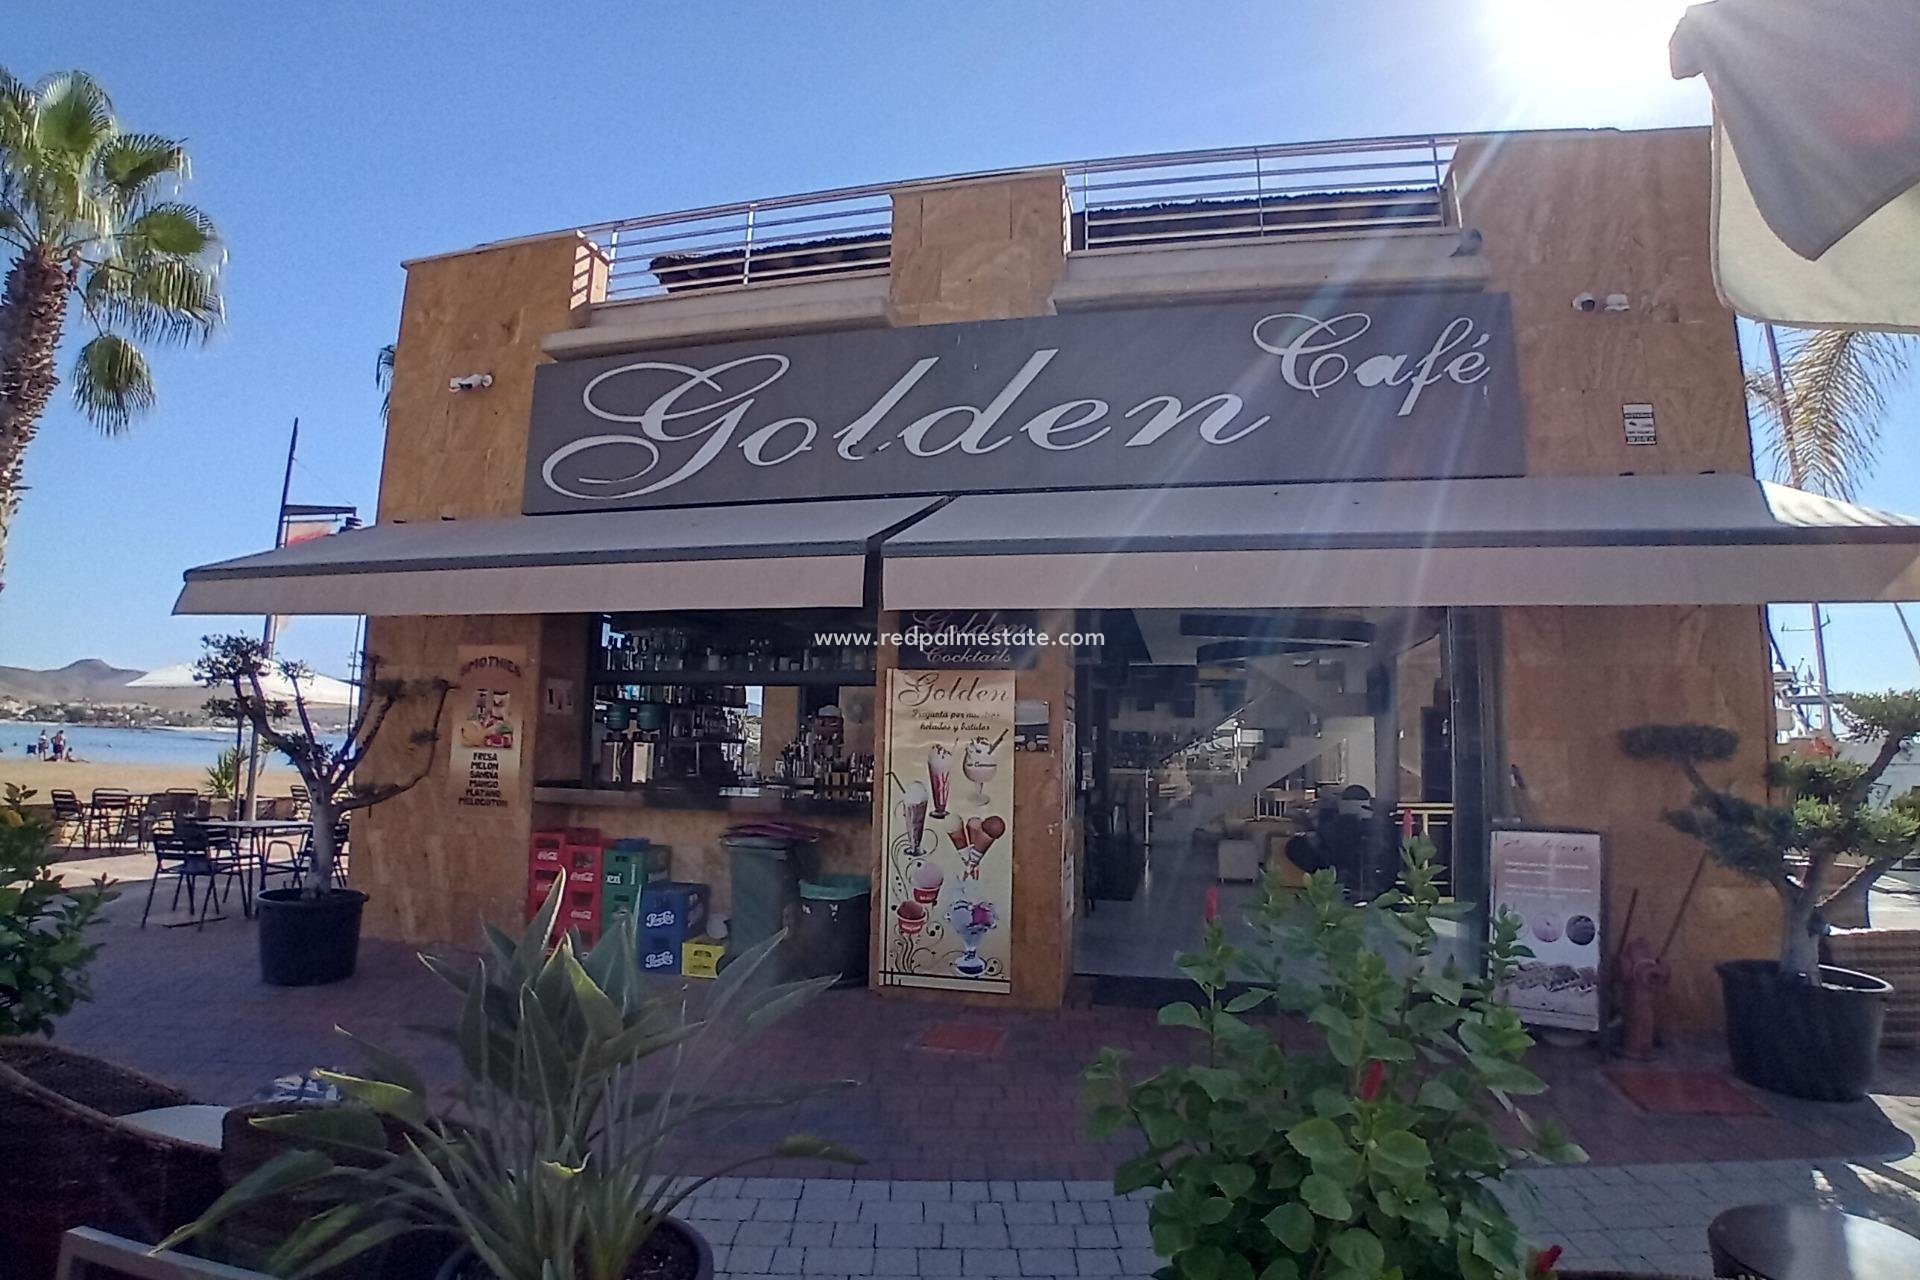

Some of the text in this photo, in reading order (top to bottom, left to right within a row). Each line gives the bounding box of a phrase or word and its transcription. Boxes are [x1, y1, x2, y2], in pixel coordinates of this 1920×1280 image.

[541, 312, 1491, 499] Golden Café
[905, 610, 1027, 641] Golden
[923, 647, 1011, 663] Cocktails
[899, 672, 1009, 707] Golden
[473, 752, 498, 761] FRESA
